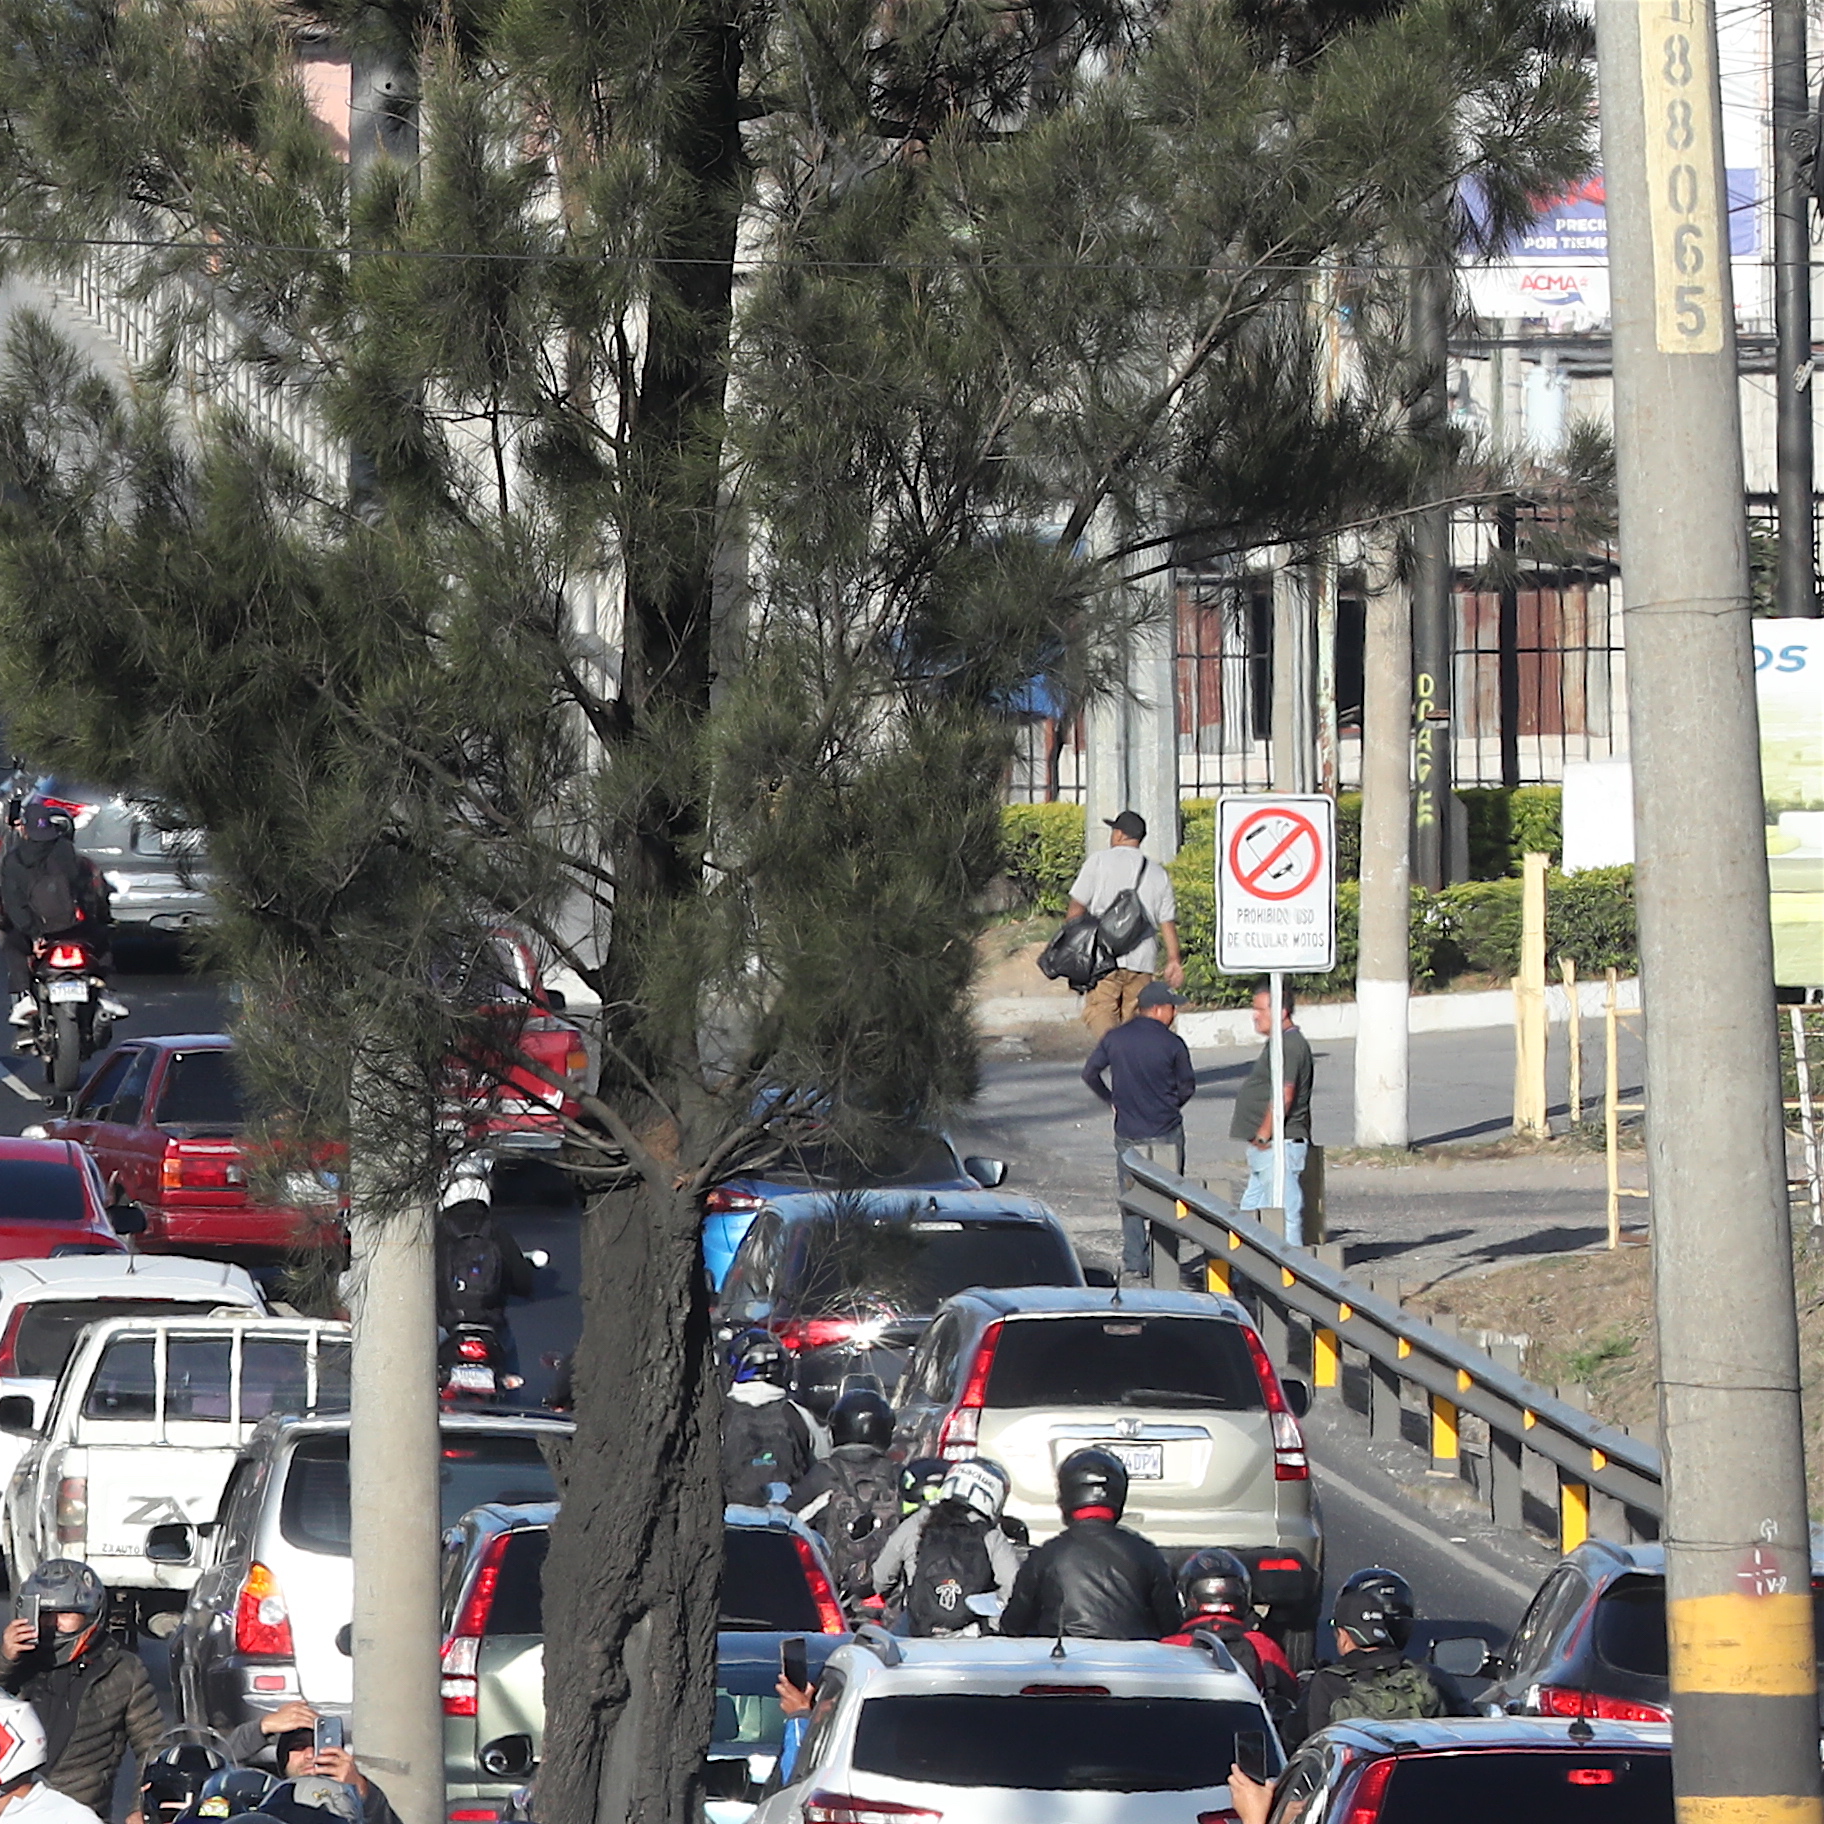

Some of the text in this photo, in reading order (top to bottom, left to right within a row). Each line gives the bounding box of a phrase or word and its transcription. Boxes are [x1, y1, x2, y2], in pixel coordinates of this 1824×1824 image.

[1524, 235, 1609, 250] POR TIEMP
[1520, 274, 1578, 291] ACMA
[1237, 907, 1315, 925] PROHIBIDO USO
[1226, 931, 1325, 949] DE CELULAR MOTOS
